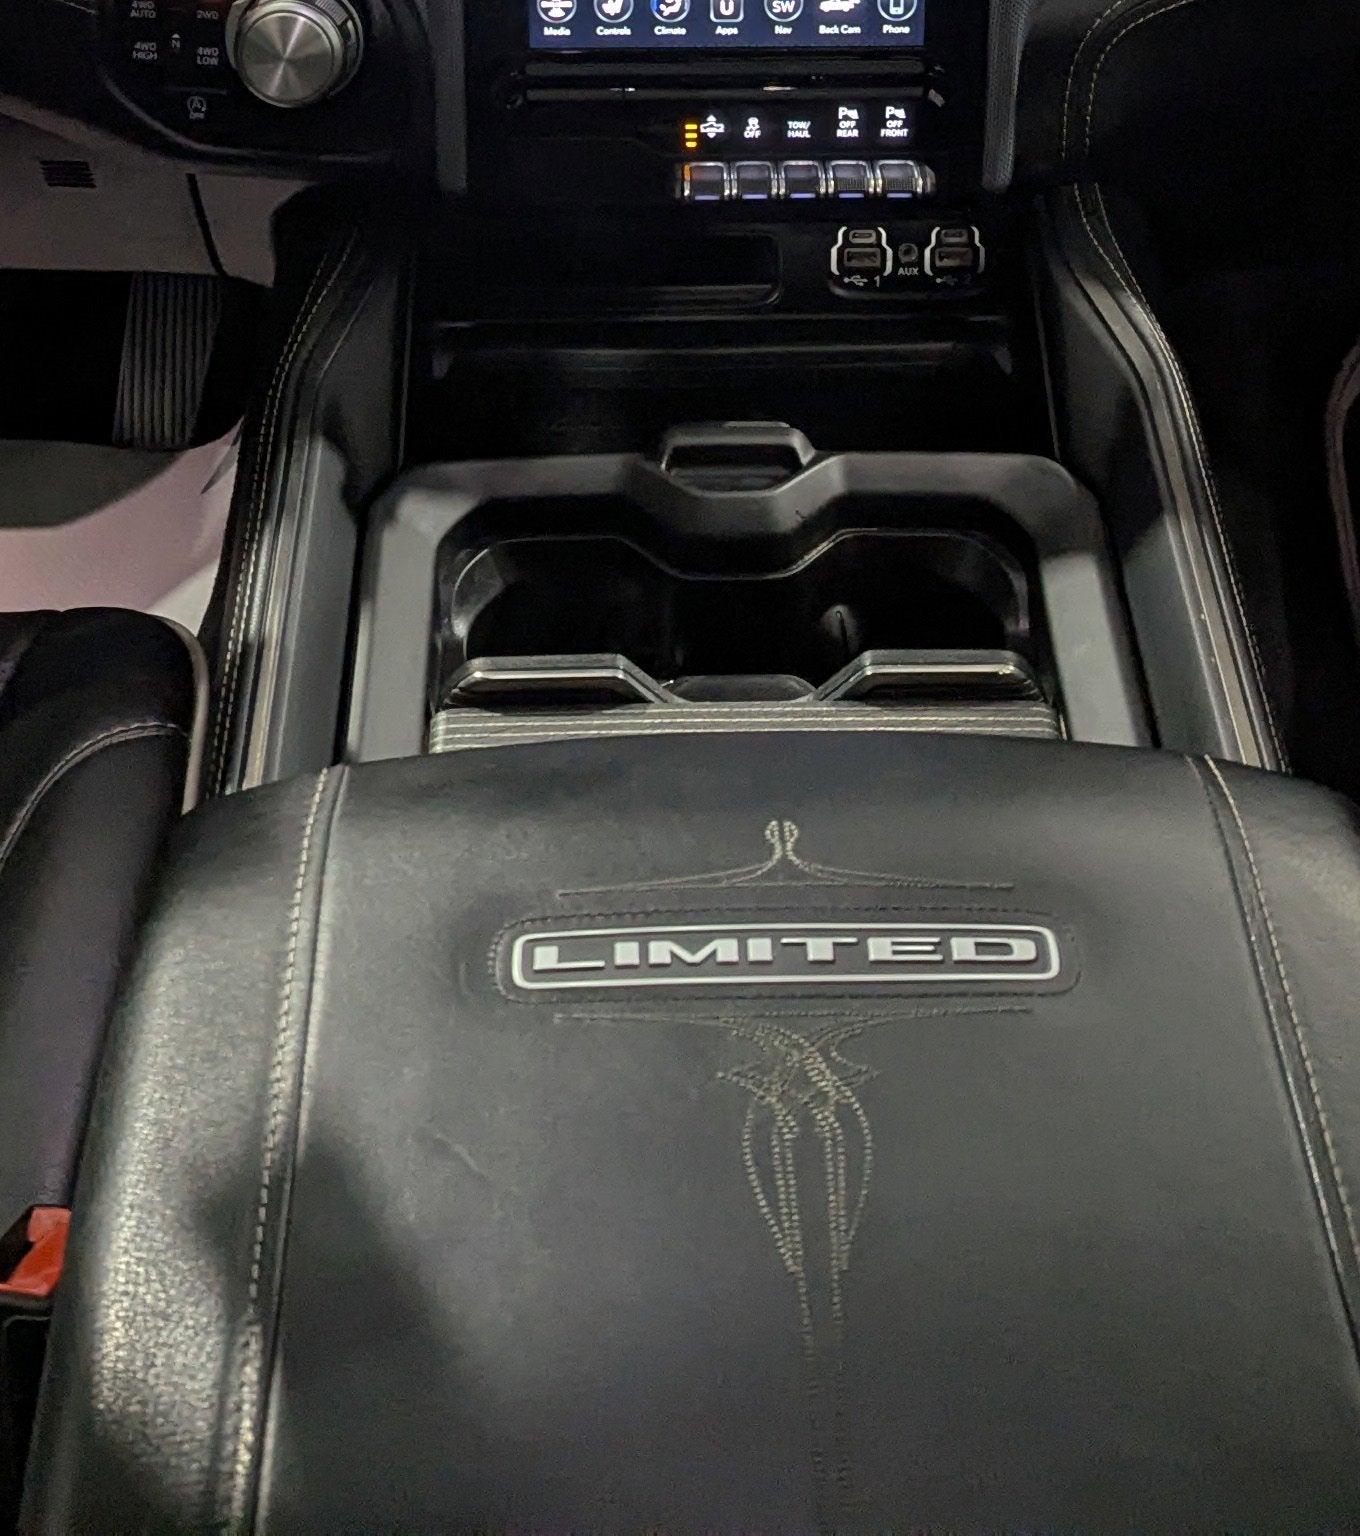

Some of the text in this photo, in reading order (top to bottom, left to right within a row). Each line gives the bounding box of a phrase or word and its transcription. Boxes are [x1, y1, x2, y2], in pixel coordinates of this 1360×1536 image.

[131, 0, 155, 9] 4WD
[772, 0, 796, 13] SW
[130, 10, 157, 19] AUTO
[196, 10, 220, 20] 2WD
[543, 26, 571, 37] Media
[596, 26, 631, 36] Controls
[654, 25, 687, 36] Climate
[715, 25, 739, 37] Apps
[774, 25, 793, 35] Nav
[819, 24, 861, 35] Back Cam
[882, 24, 910, 34] Phone
[133, 41, 156, 51] 4WD
[171, 39, 181, 48] N
[132, 50, 158, 60] HIGH
[197, 47, 219, 56] 4WD
[196, 56, 219, 65] LOW
[788, 120, 811, 130] TOW/
[839, 120, 857, 129] OFF
[886, 120, 903, 129] OFF
[744, 129, 761, 138] OFF
[787, 129, 811, 138] HAUL
[837, 129, 859, 138] REAR
[881, 128, 909, 138] FRONT
[898, 267, 919, 276] AUX
[874, 275, 880, 287] 1
[533, 936, 1038, 970] LIMITED
